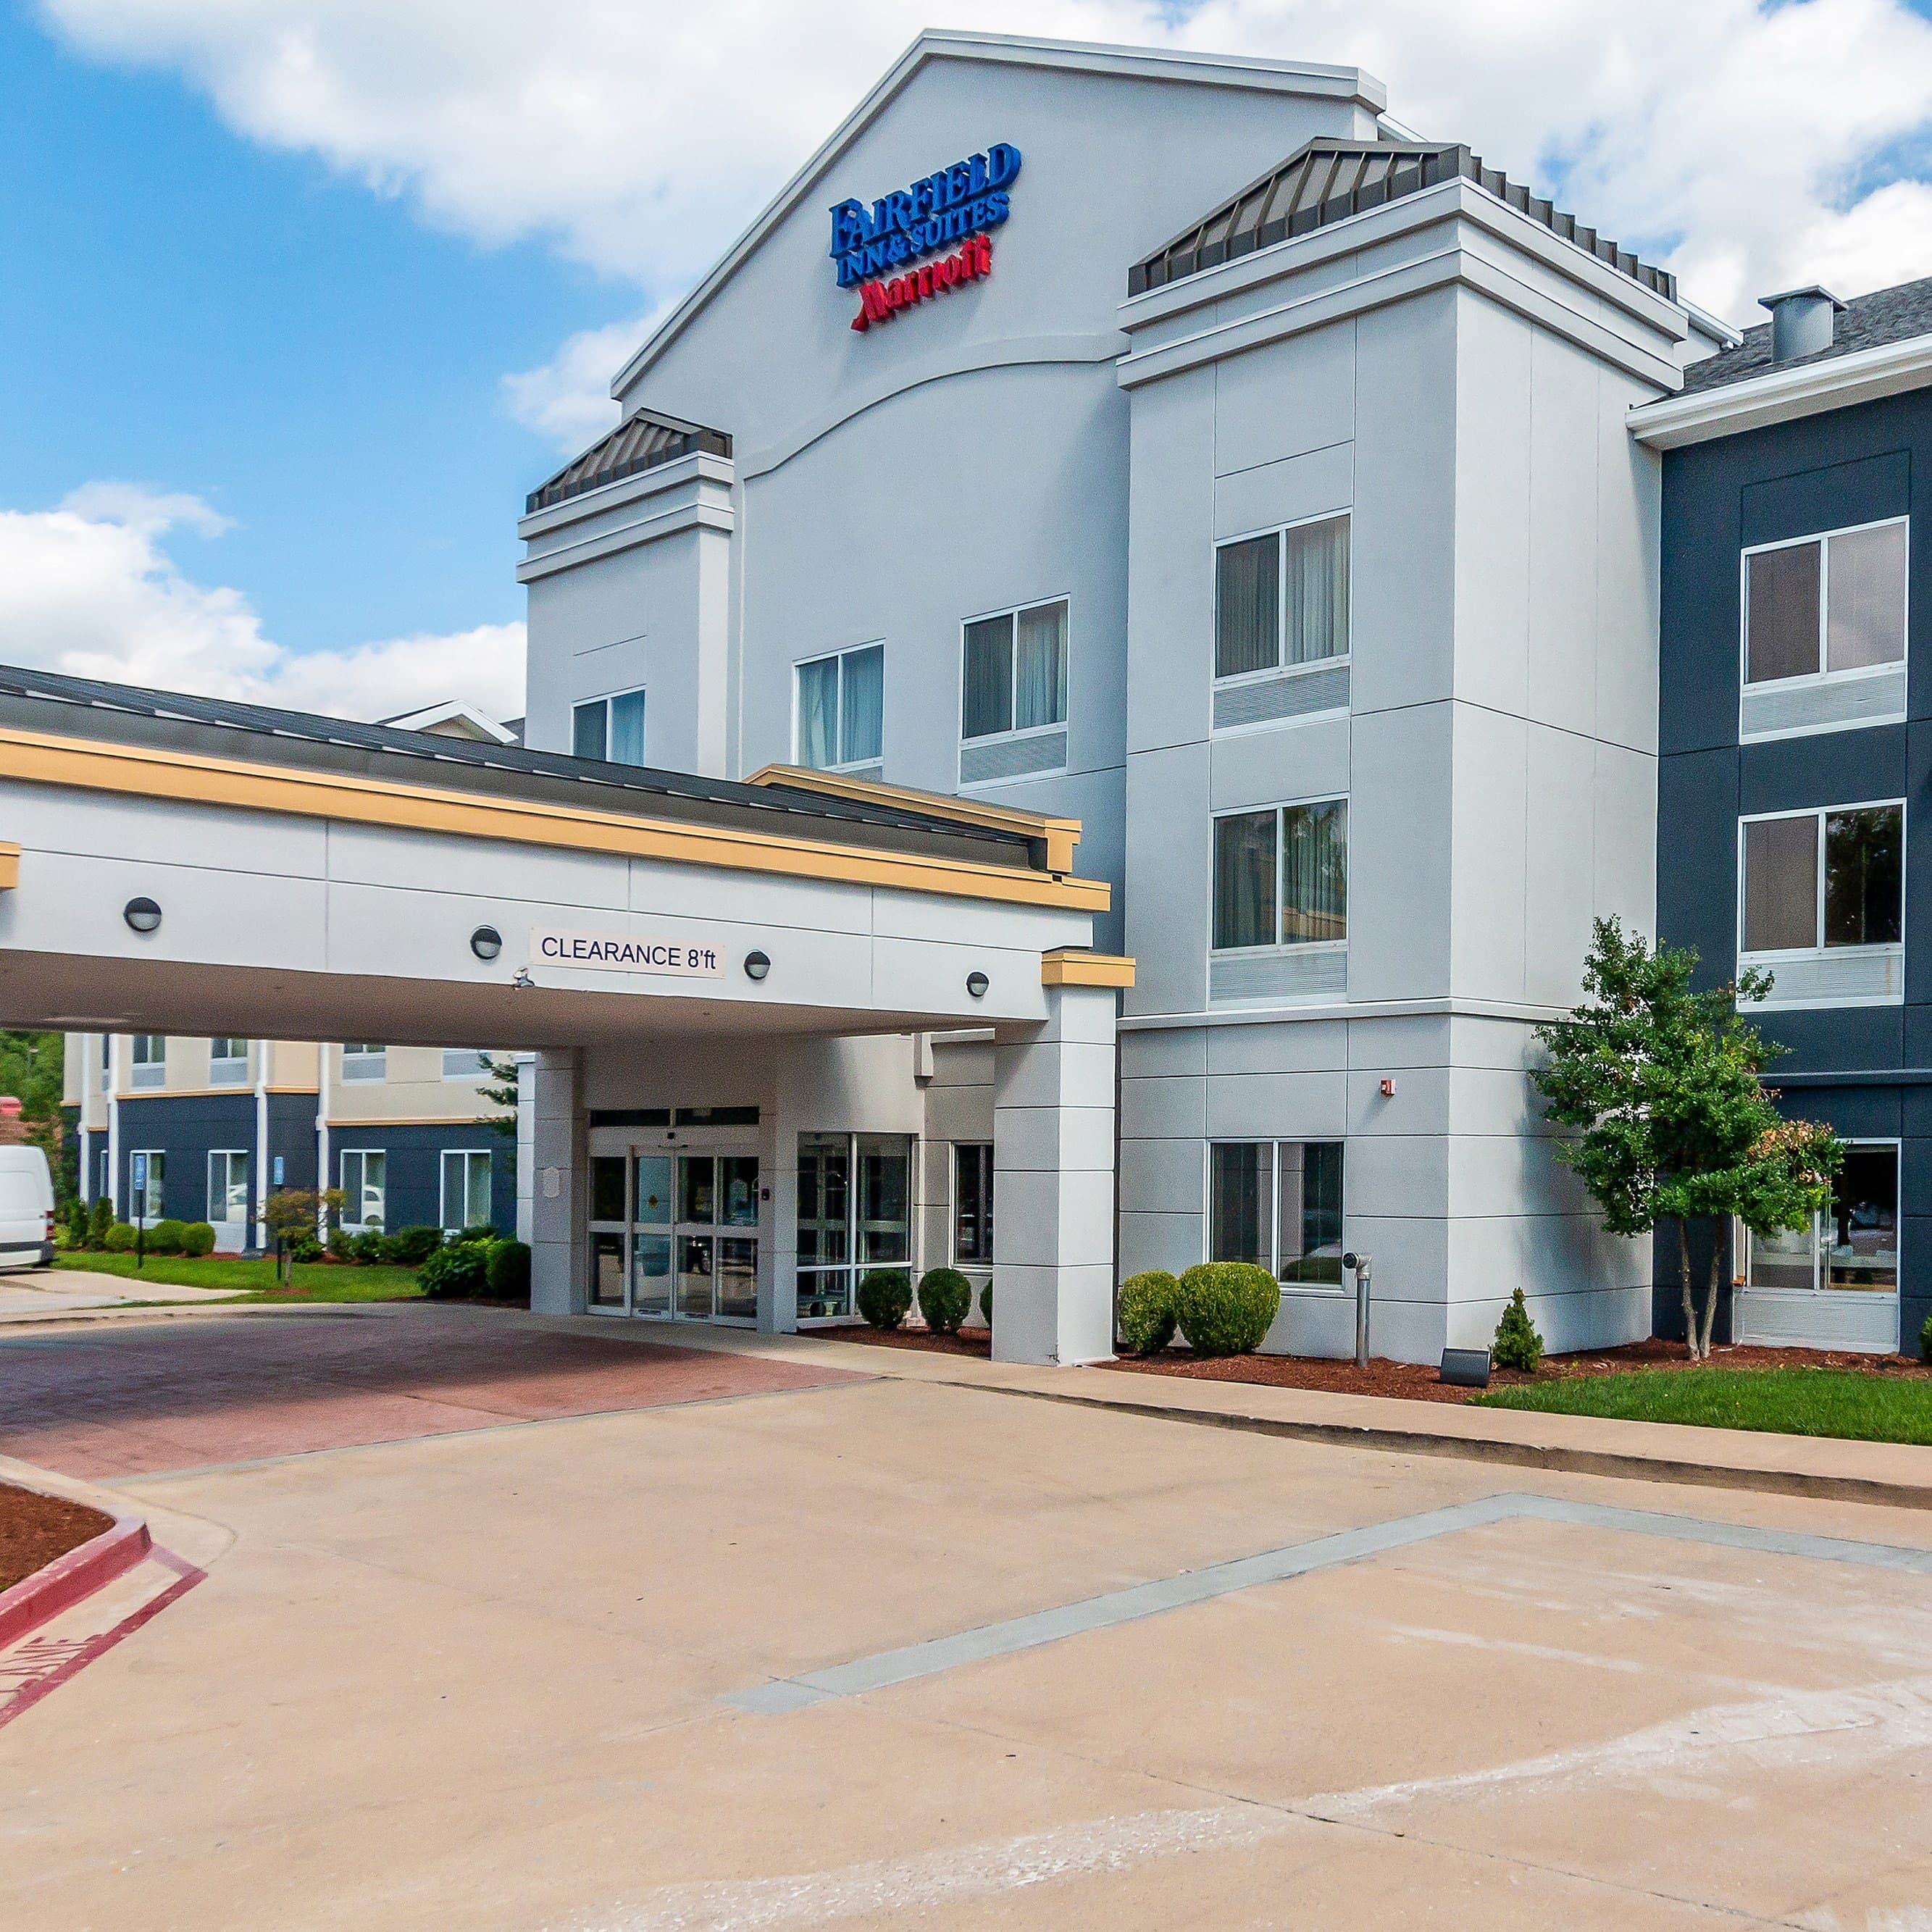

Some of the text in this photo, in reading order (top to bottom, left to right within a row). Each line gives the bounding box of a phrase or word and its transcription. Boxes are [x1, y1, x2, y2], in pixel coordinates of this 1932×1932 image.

[829, 142, 1022, 259] FAIRFIELD
[850, 233, 992, 332] Marriott
[541, 937, 681, 966] CLEARANCE
